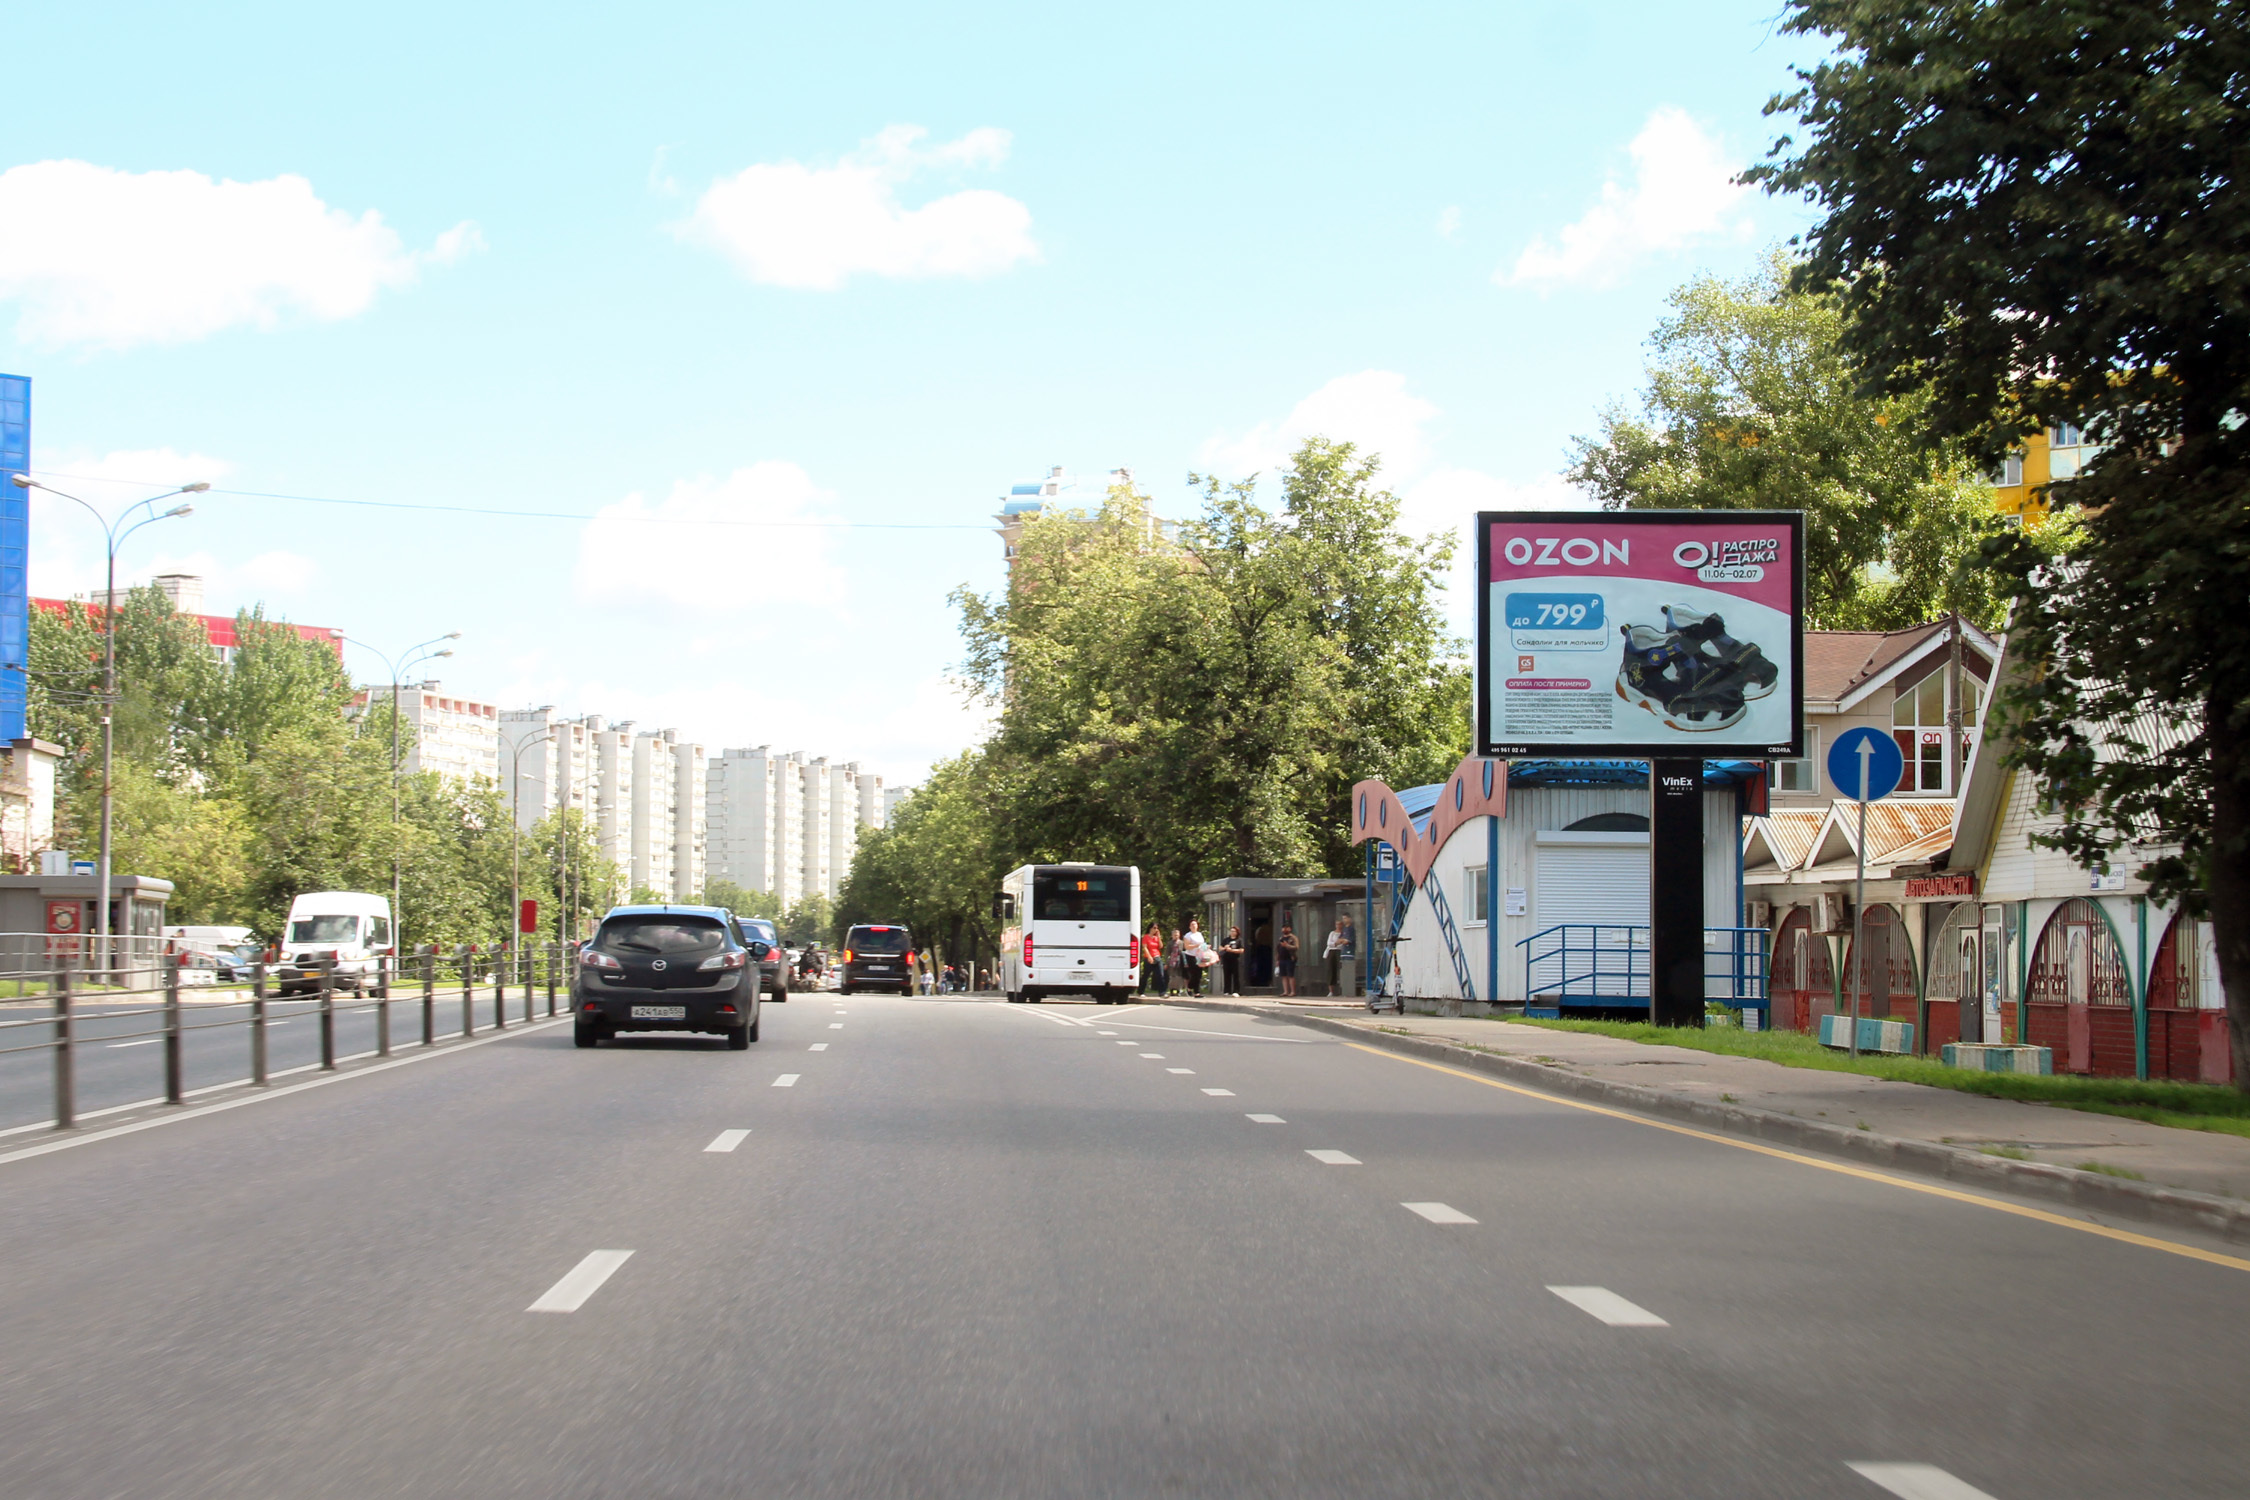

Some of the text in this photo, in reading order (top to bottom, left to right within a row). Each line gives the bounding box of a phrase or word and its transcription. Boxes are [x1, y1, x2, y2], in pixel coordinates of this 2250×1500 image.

[1505, 537, 1629, 566] OZON
[1722, 538, 1778, 552] РАСПРО
[1721, 551, 1777, 567] ДАЖА
[1512, 617, 1530, 627] до
[1536, 603, 1587, 626] 799
[1516, 638, 1553, 647] Сандалии
[1662, 776, 1693, 786] VinEx
[1077, 881, 1088, 891] 11
[1905, 876, 1969, 897] АВТОЗАПЧАСТИ
